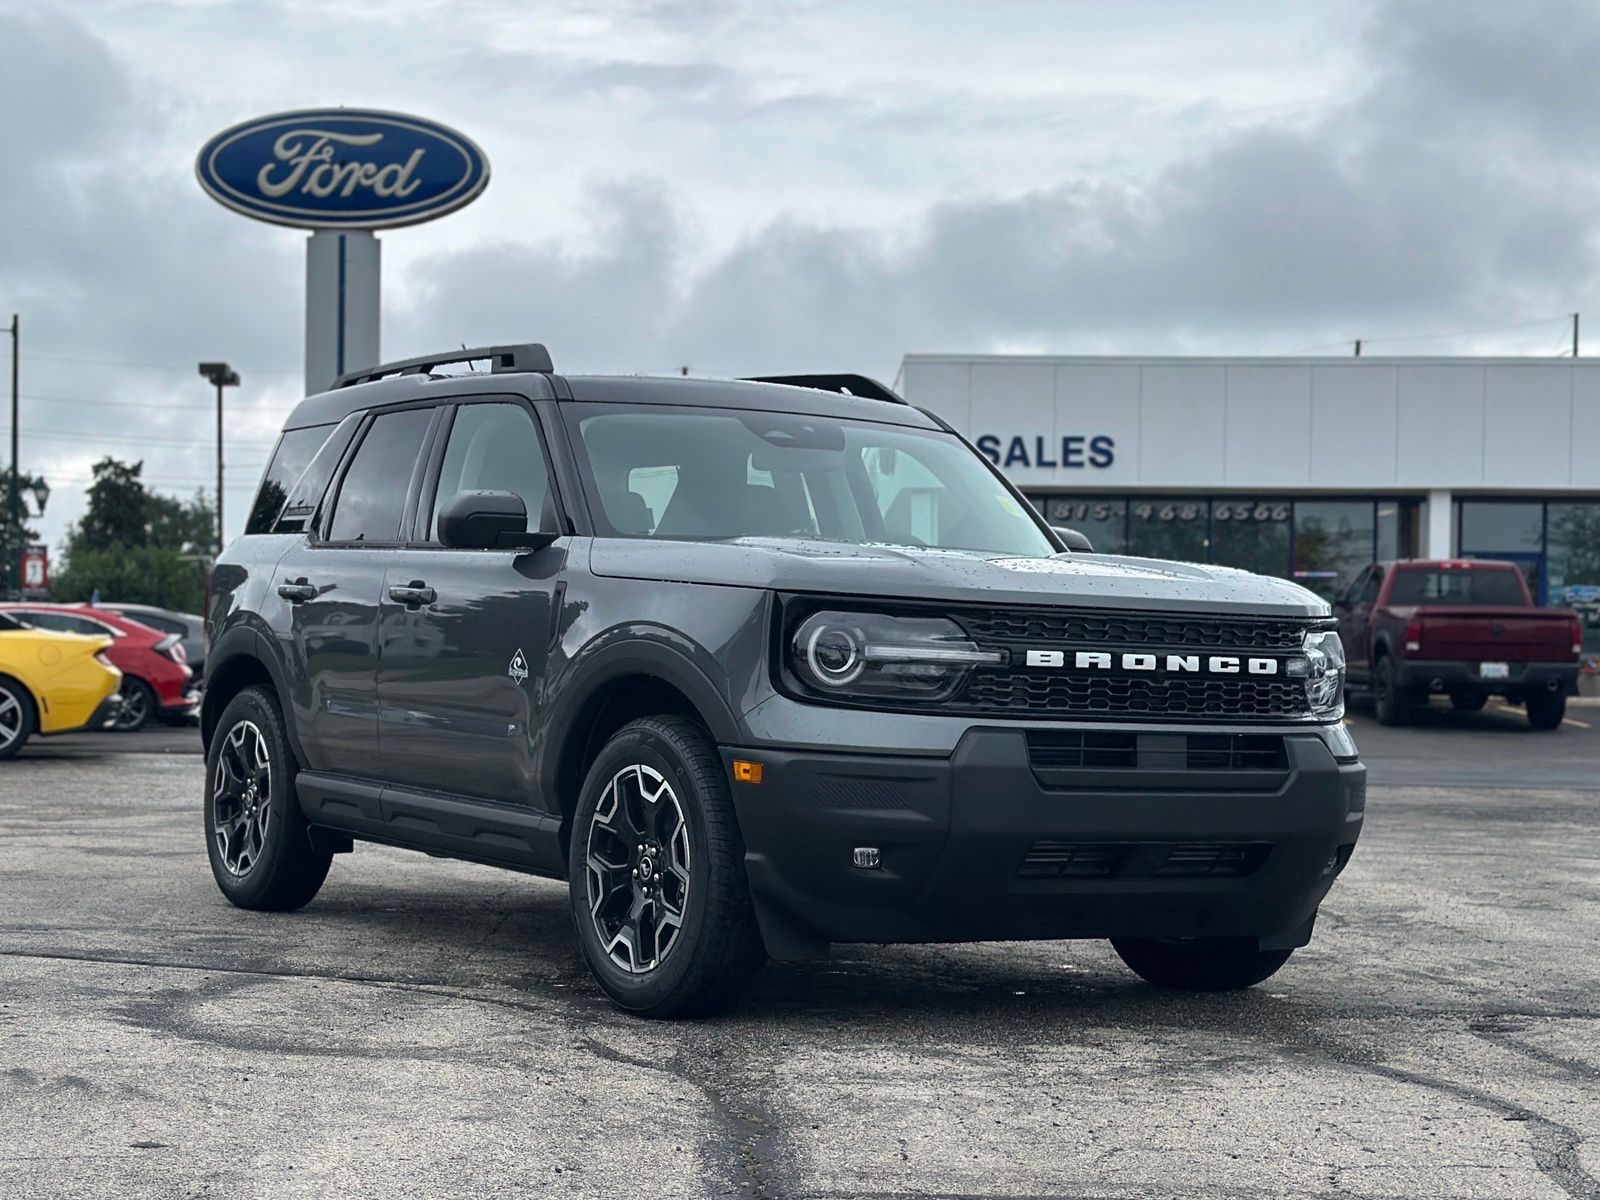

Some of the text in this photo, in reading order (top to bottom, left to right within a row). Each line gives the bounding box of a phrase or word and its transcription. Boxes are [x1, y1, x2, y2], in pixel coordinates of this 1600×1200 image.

[257, 129, 425, 197] Ford
[976, 435, 1114, 468] SALES
[1026, 650, 1278, 675] BRONCO
